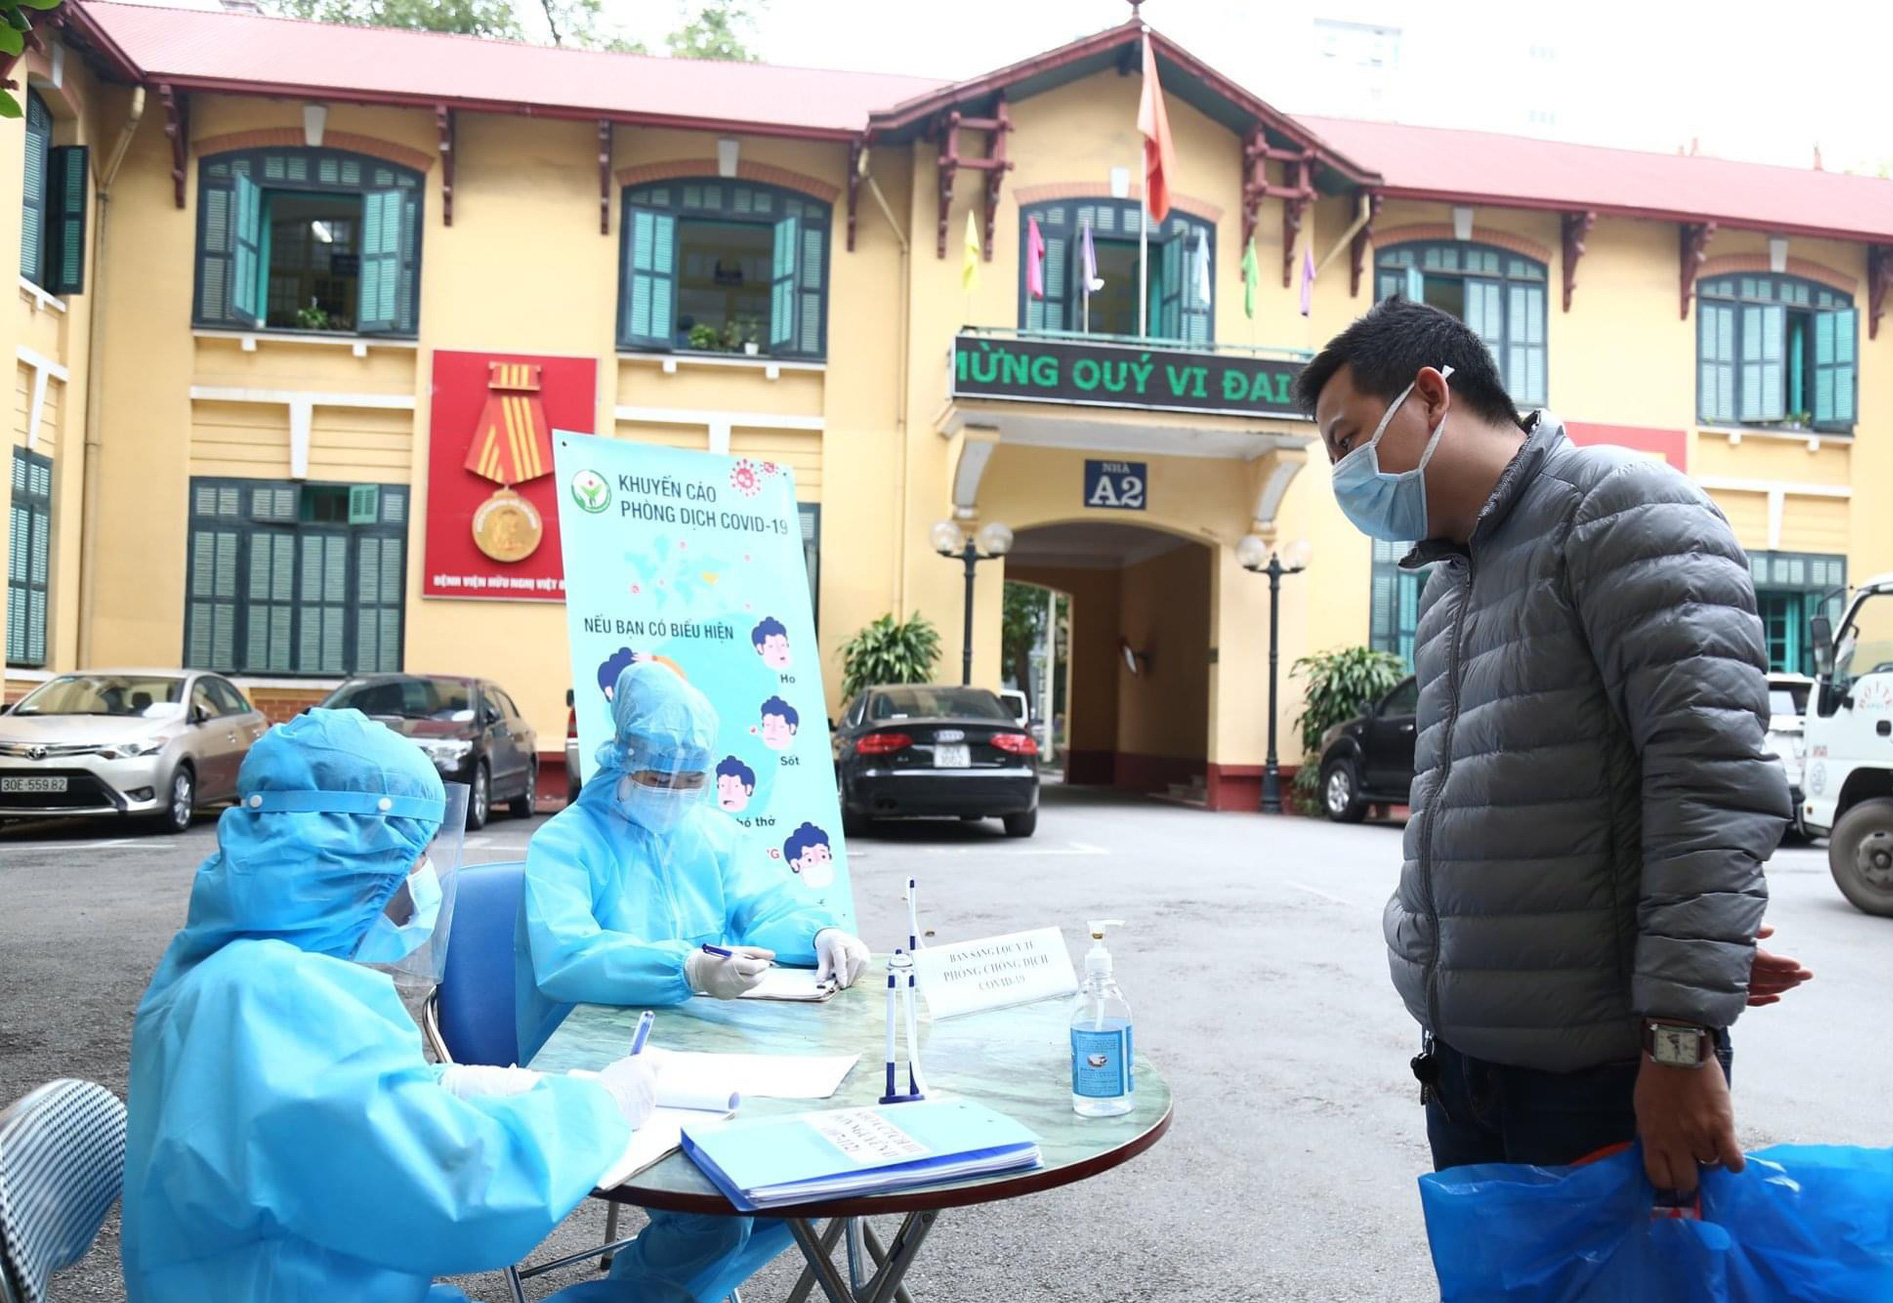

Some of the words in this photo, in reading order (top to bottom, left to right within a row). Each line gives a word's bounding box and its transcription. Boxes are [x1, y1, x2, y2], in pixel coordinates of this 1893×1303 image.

[618, 474, 681, 498] KHUYẾN
[1089, 475, 1143, 507] A2
[621, 500, 676, 523] PHÒNG
[680, 507, 717, 531] DỊCH
[720, 512, 789, 535] COVID-19
[584, 613, 612, 634] NẾU
[616, 619, 645, 640] BẠN
[649, 619, 667, 637] CÓ
[704, 621, 734, 643] HIỆN
[780, 674, 796, 684] Ho
[780, 754, 800, 766] Sốt
[755, 815, 776, 827] thở
